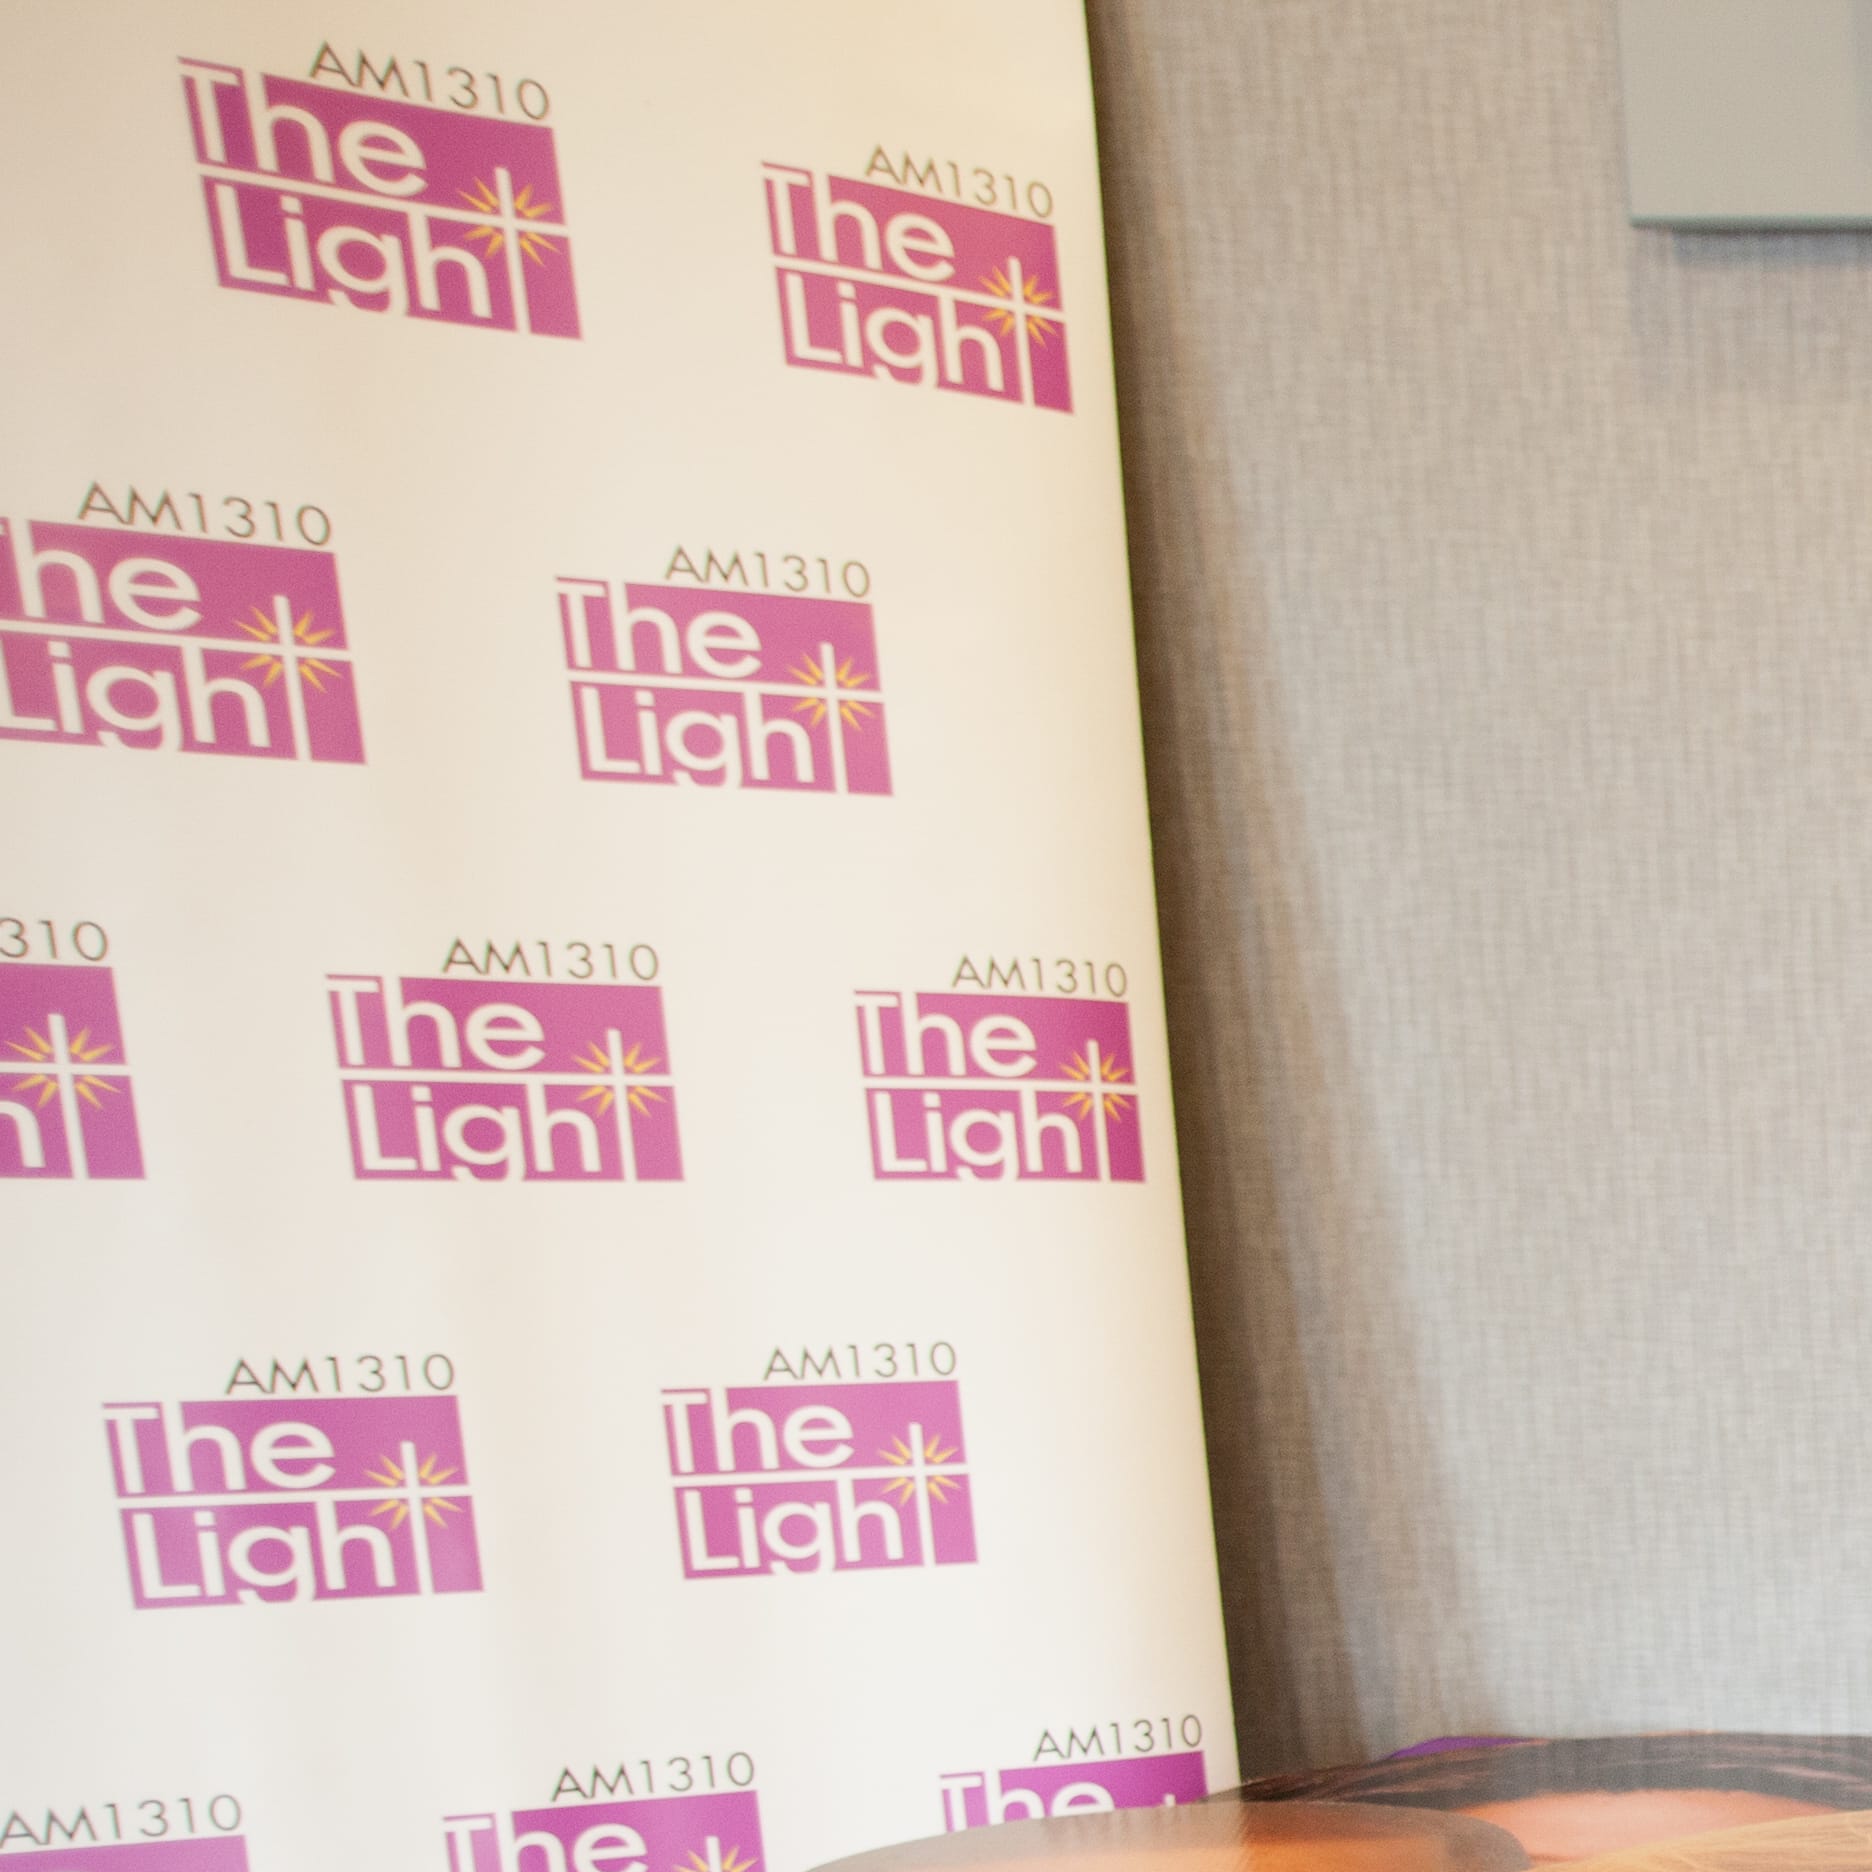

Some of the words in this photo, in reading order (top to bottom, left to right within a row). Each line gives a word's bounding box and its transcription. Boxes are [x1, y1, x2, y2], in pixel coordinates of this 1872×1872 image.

[309, 42, 550, 122] AM1310
[179, 57, 427, 197] The
[762, 162, 955, 283] The
[864, 145, 1054, 217] AM1310
[213, 166, 537, 338] Light
[781, 257, 1037, 402] Light
[78, 481, 331, 546] AM1310
[666, 547, 870, 598] AM1310
[556, 576, 762, 678] The
[581, 643, 845, 793] Light
[442, 938, 660, 982] AM1310
[952, 956, 1128, 998] AM1310
[326, 973, 545, 1071] The
[855, 990, 1035, 1076] The
[352, 1027, 637, 1180] Light
[872, 1040, 1113, 1183] Light
[225, 1353, 456, 1396] AM1310
[764, 1341, 956, 1381] AM1310
[103, 1398, 335, 1493] The
[662, 1386, 855, 1474] The
[130, 1442, 430, 1603] Light
[684, 1422, 935, 1574] Light
[551, 1752, 755, 1802] AM1310
[1033, 1714, 1202, 1761] AM1310
[0, 1794, 241, 1848] AM1310
